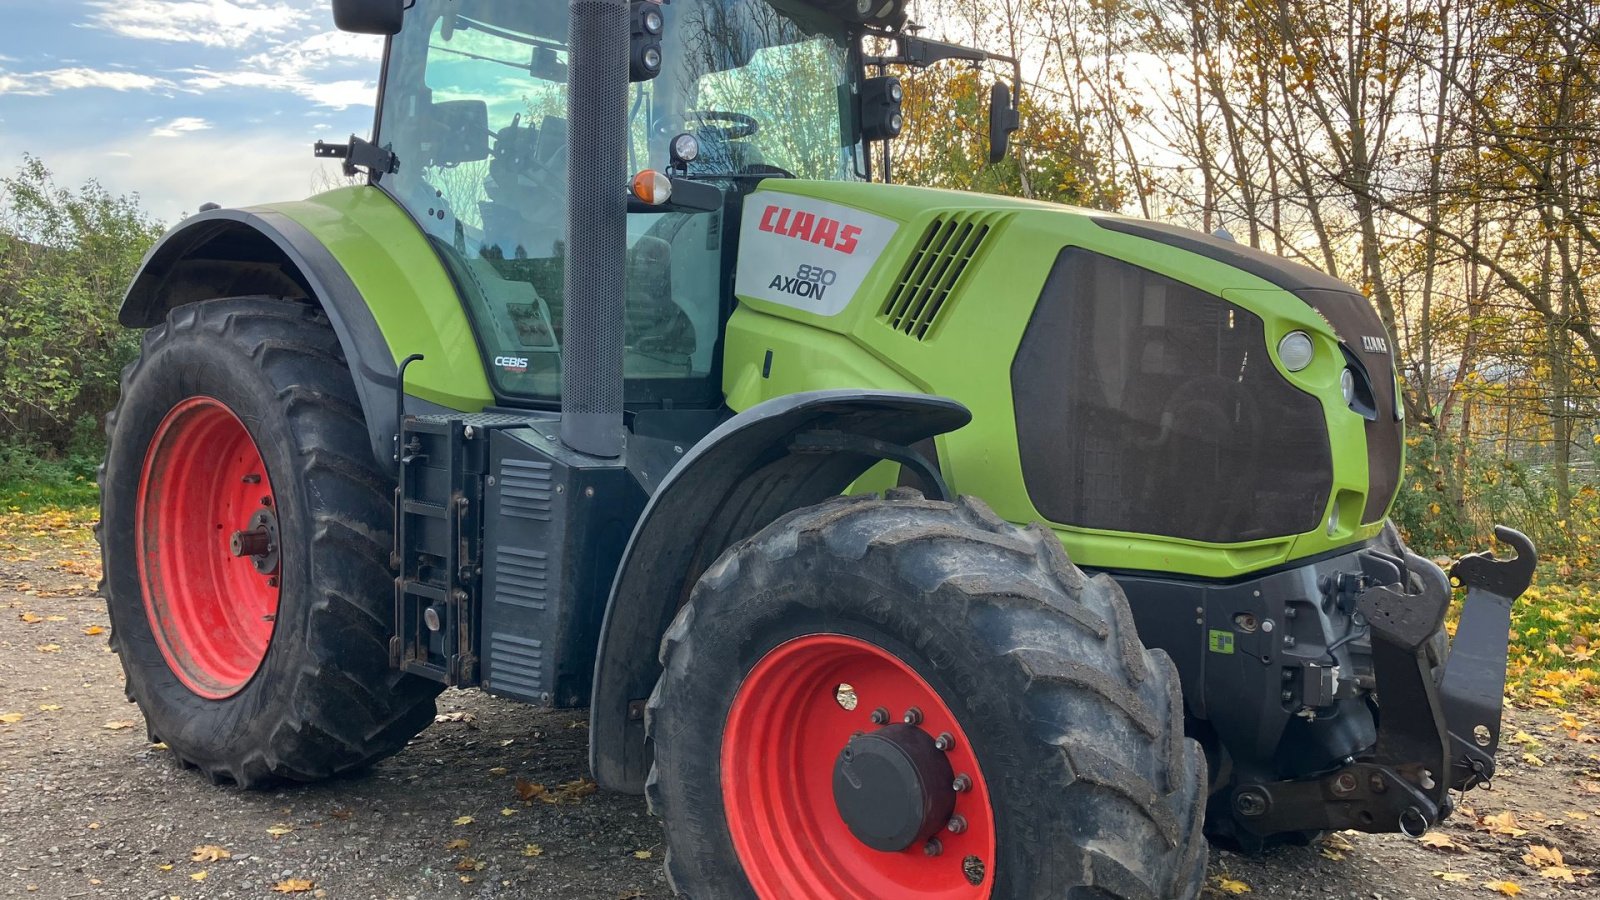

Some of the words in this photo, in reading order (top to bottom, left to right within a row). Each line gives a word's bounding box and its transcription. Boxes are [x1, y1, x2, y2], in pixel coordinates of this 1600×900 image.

[758, 205, 862, 254] CLAAS
[796, 264, 837, 286] 830
[768, 275, 826, 300] AXION
[494, 356, 529, 368] CEBIS
